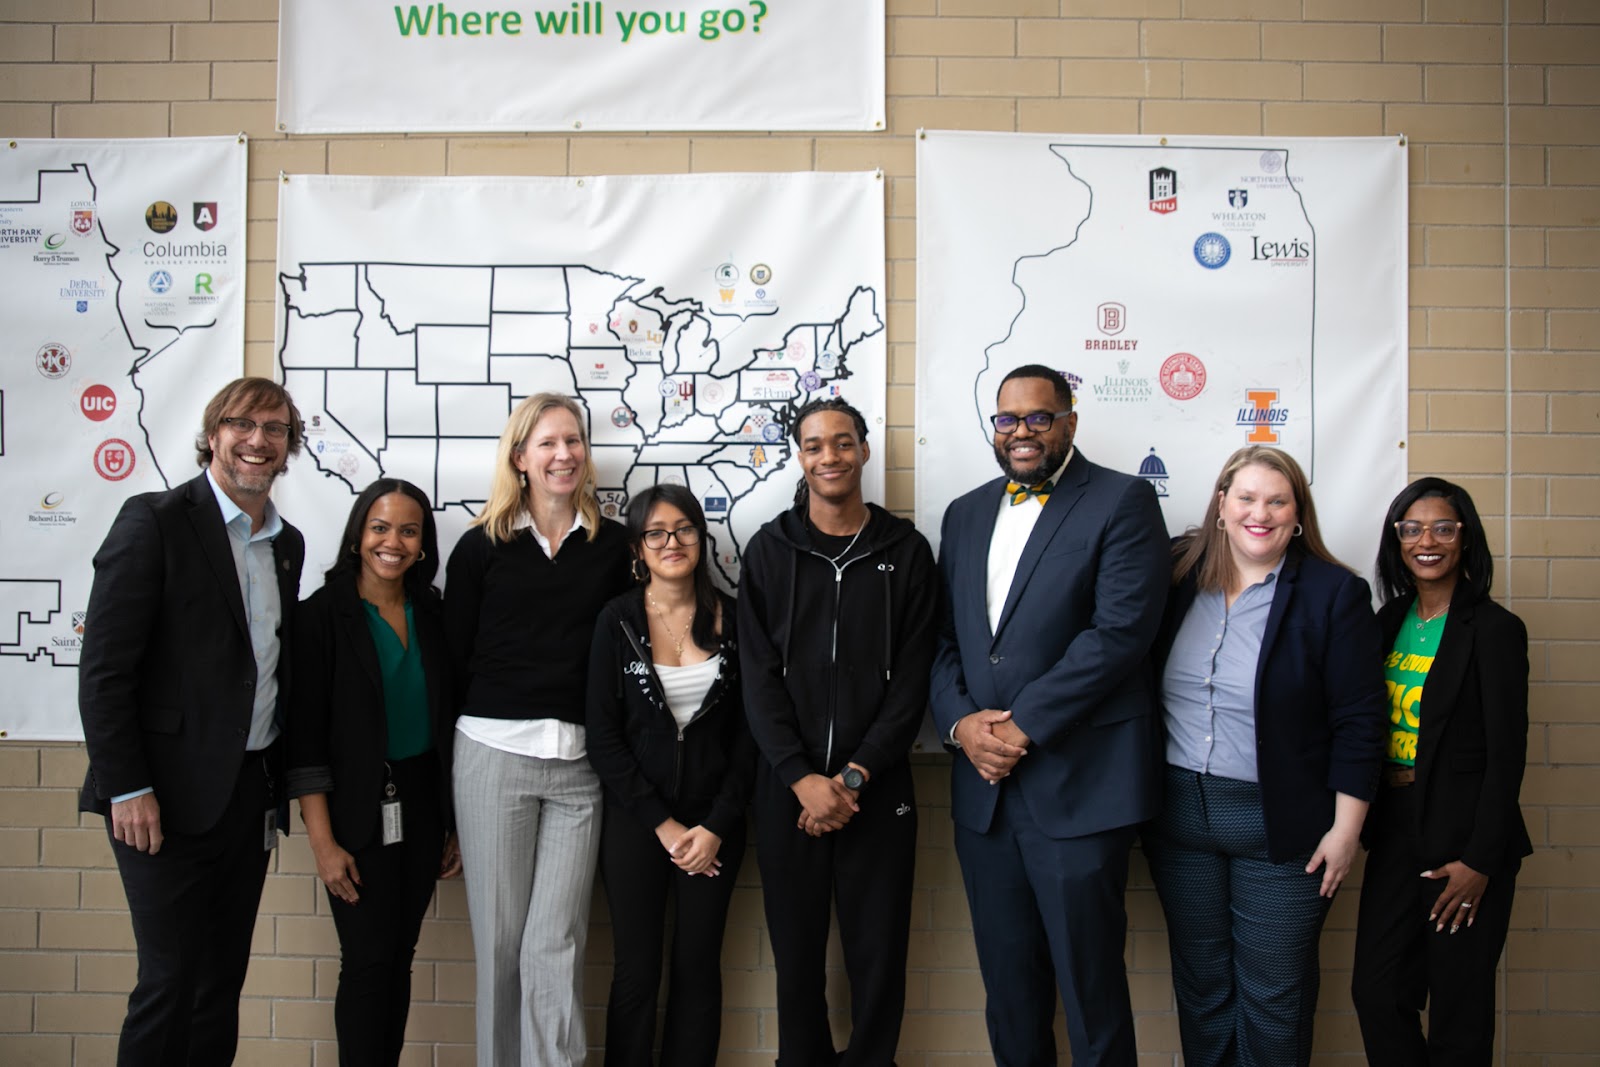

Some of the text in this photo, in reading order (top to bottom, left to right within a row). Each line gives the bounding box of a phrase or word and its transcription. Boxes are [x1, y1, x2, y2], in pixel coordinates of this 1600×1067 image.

[395, 1, 768, 43] Where will you go?
[1151, 201, 1175, 212] NIU
[1211, 213, 1267, 221] WHEATON
[143, 241, 228, 258] Columbia
[1250, 236, 1310, 261] Lewis
[194, 272, 214, 295] R
[60, 288, 106, 297] UNIVERSITY
[1103, 307, 1120, 330] B
[1085, 339, 1139, 351] BRADLEY
[1104, 375, 1148, 387] ILLINOIS
[1093, 384, 1152, 396] WESLEYAN
[83, 396, 115, 411] UIC
[1236, 408, 1289, 422] ILLINOIS
[58, 515, 77, 524] Daley
[51, 636, 77, 647] Saint
